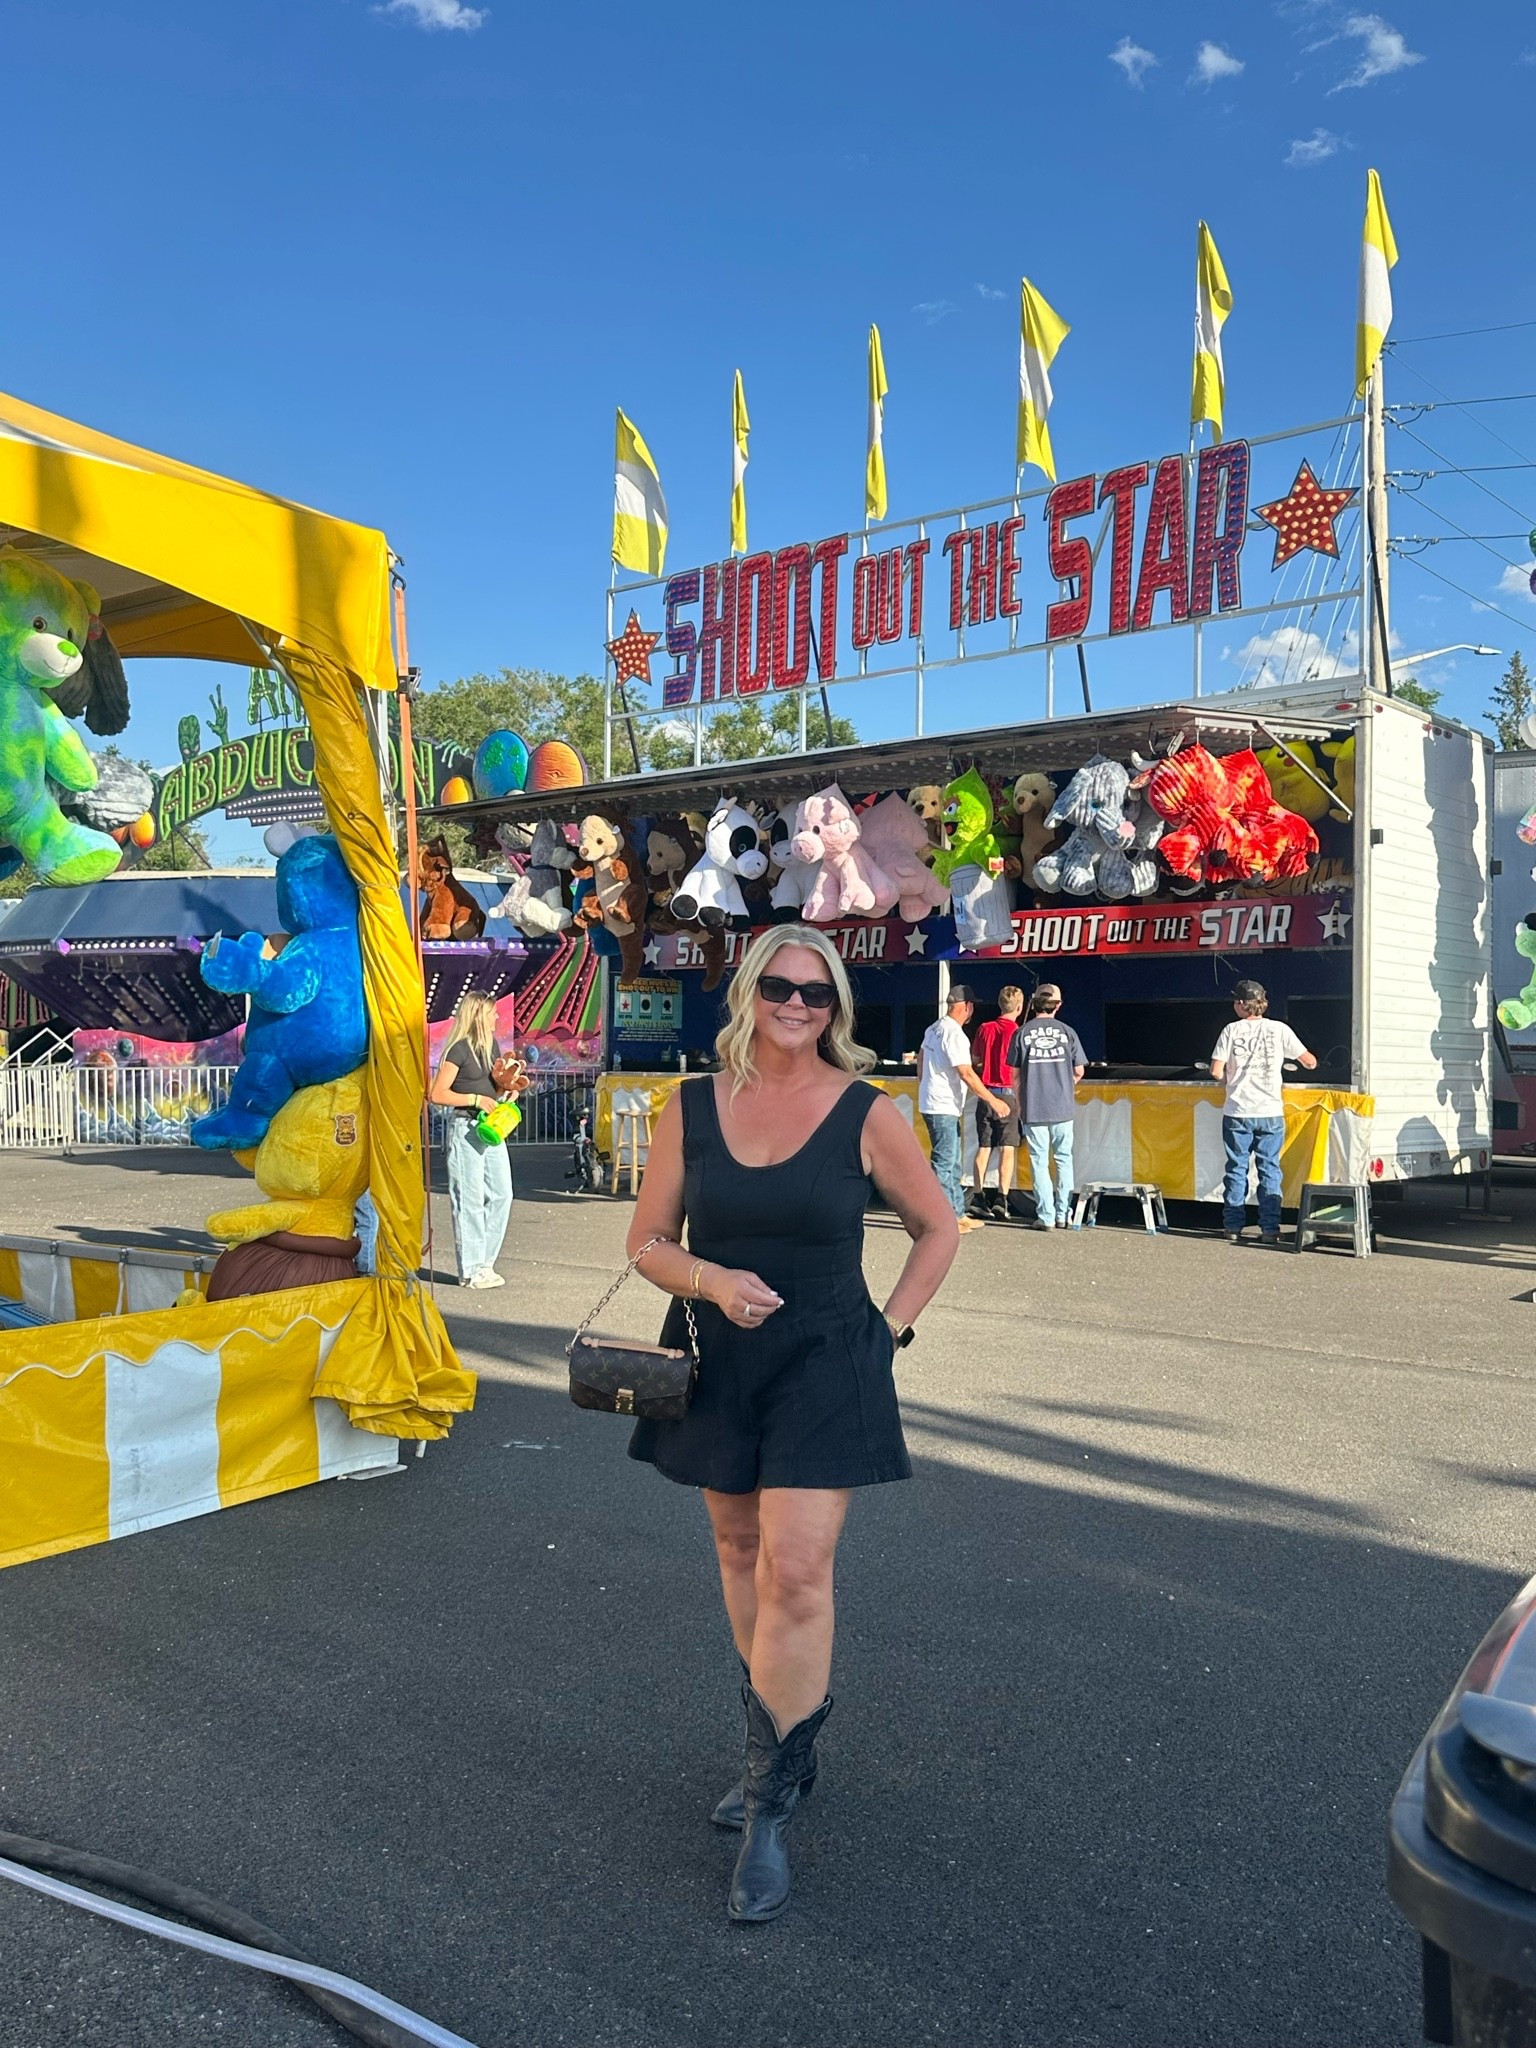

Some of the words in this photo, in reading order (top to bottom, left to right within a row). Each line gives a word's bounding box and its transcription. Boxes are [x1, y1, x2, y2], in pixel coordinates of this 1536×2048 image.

[664, 534, 848, 710] SHOOT
[851, 538, 930, 650] OUT
[943, 514, 1026, 630] THE
[1043, 438, 1251, 644] STAR
[158, 726, 434, 841] ABDUCN
[1001, 914, 1104, 953] SHOOT
[1106, 918, 1146, 943] OUT
[1153, 916, 1192, 941] THE
[1199, 904, 1292, 945] STAR
[1029, 1046, 1065, 1058] BRAND
